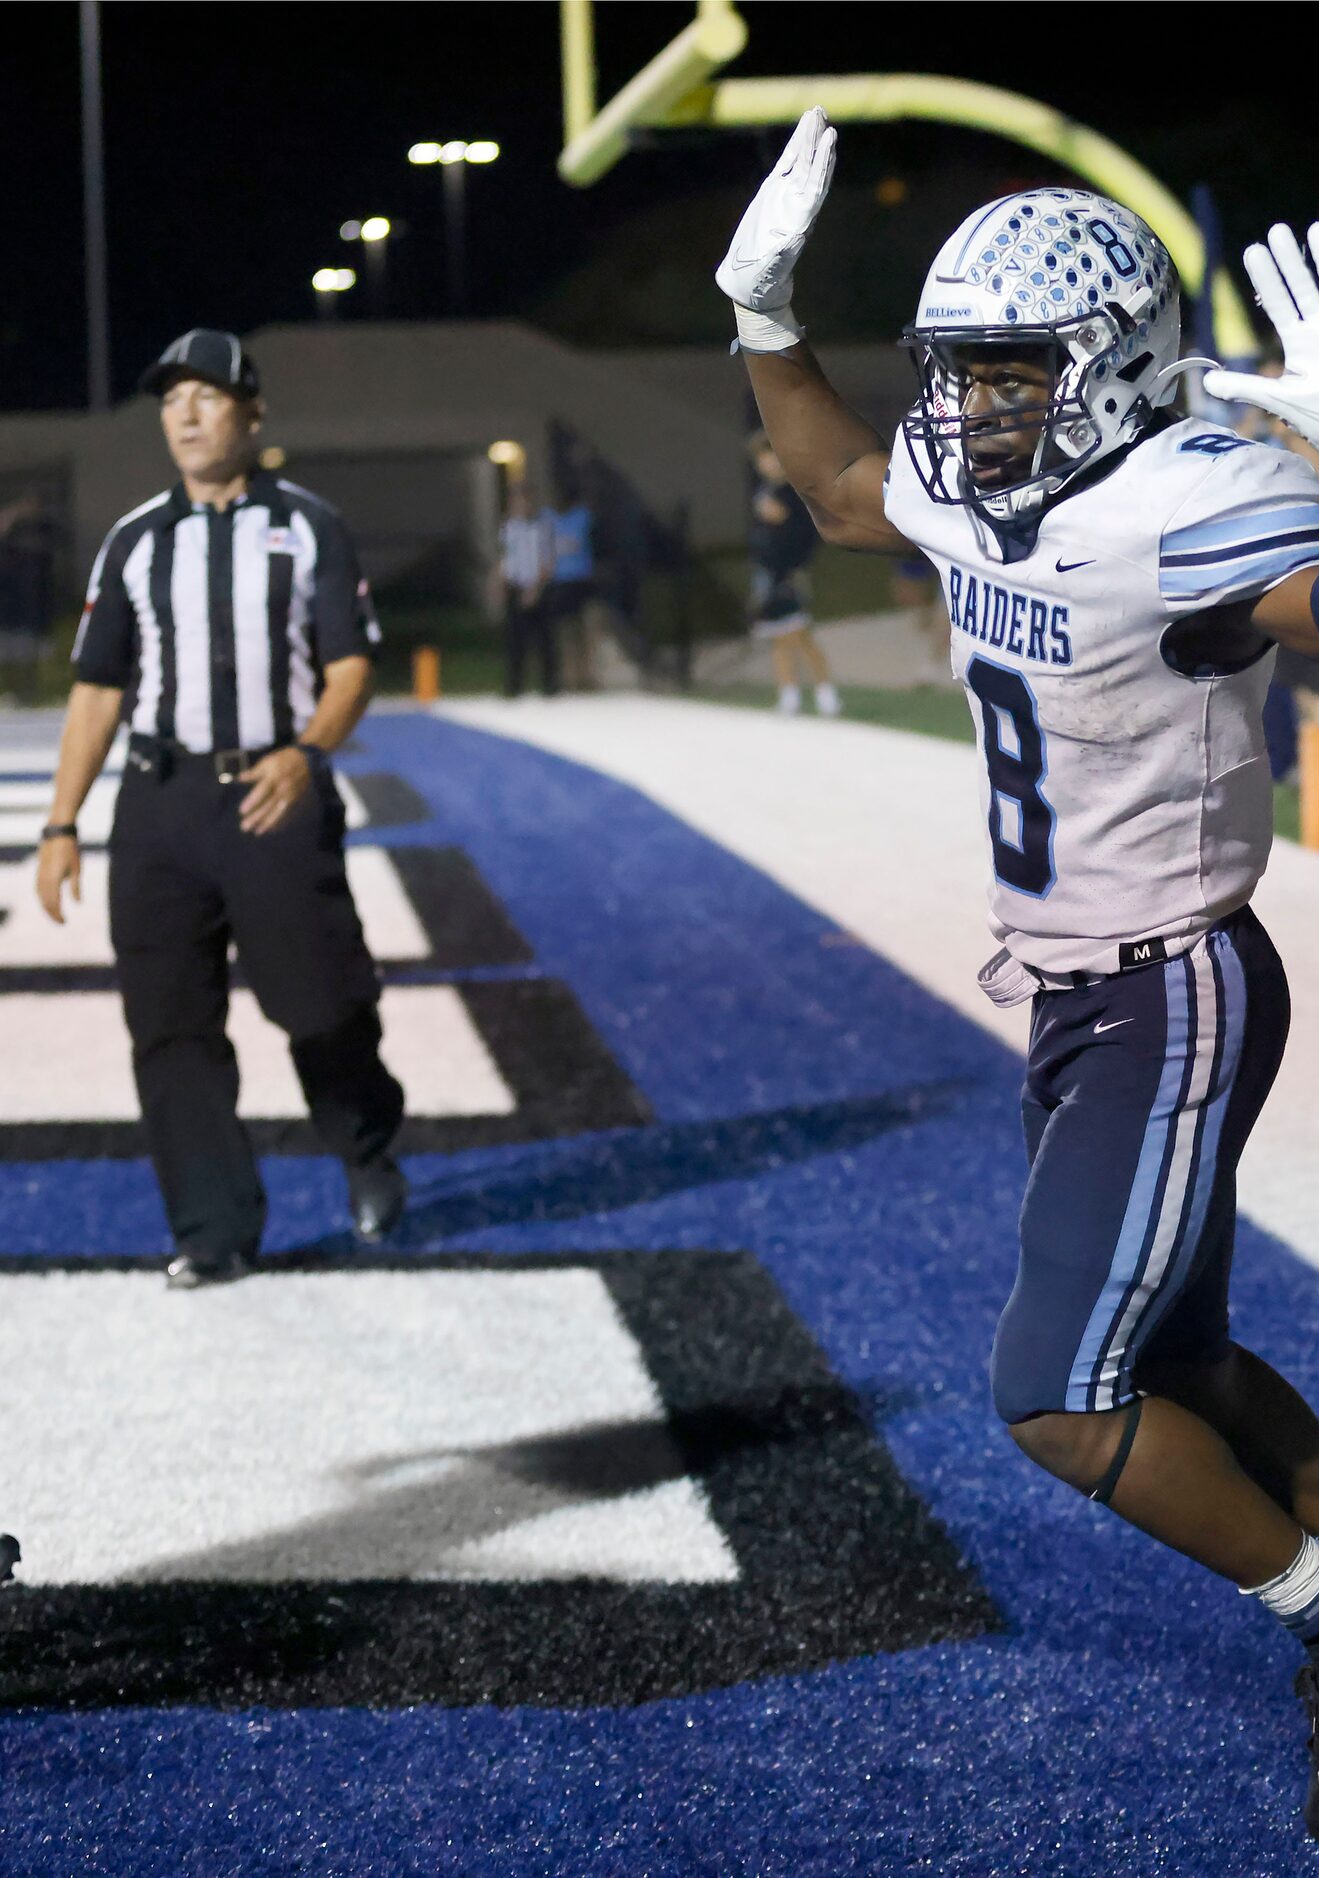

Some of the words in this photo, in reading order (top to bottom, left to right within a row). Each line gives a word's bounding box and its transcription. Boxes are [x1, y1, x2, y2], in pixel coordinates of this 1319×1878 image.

[1085, 216, 1140, 282] 8
[925, 307, 972, 318] BELLieve
[1176, 433, 1257, 455] 8
[950, 562, 1073, 667] RAIDERS
[965, 651, 1057, 901] 8
[1133, 943, 1151, 961] M
